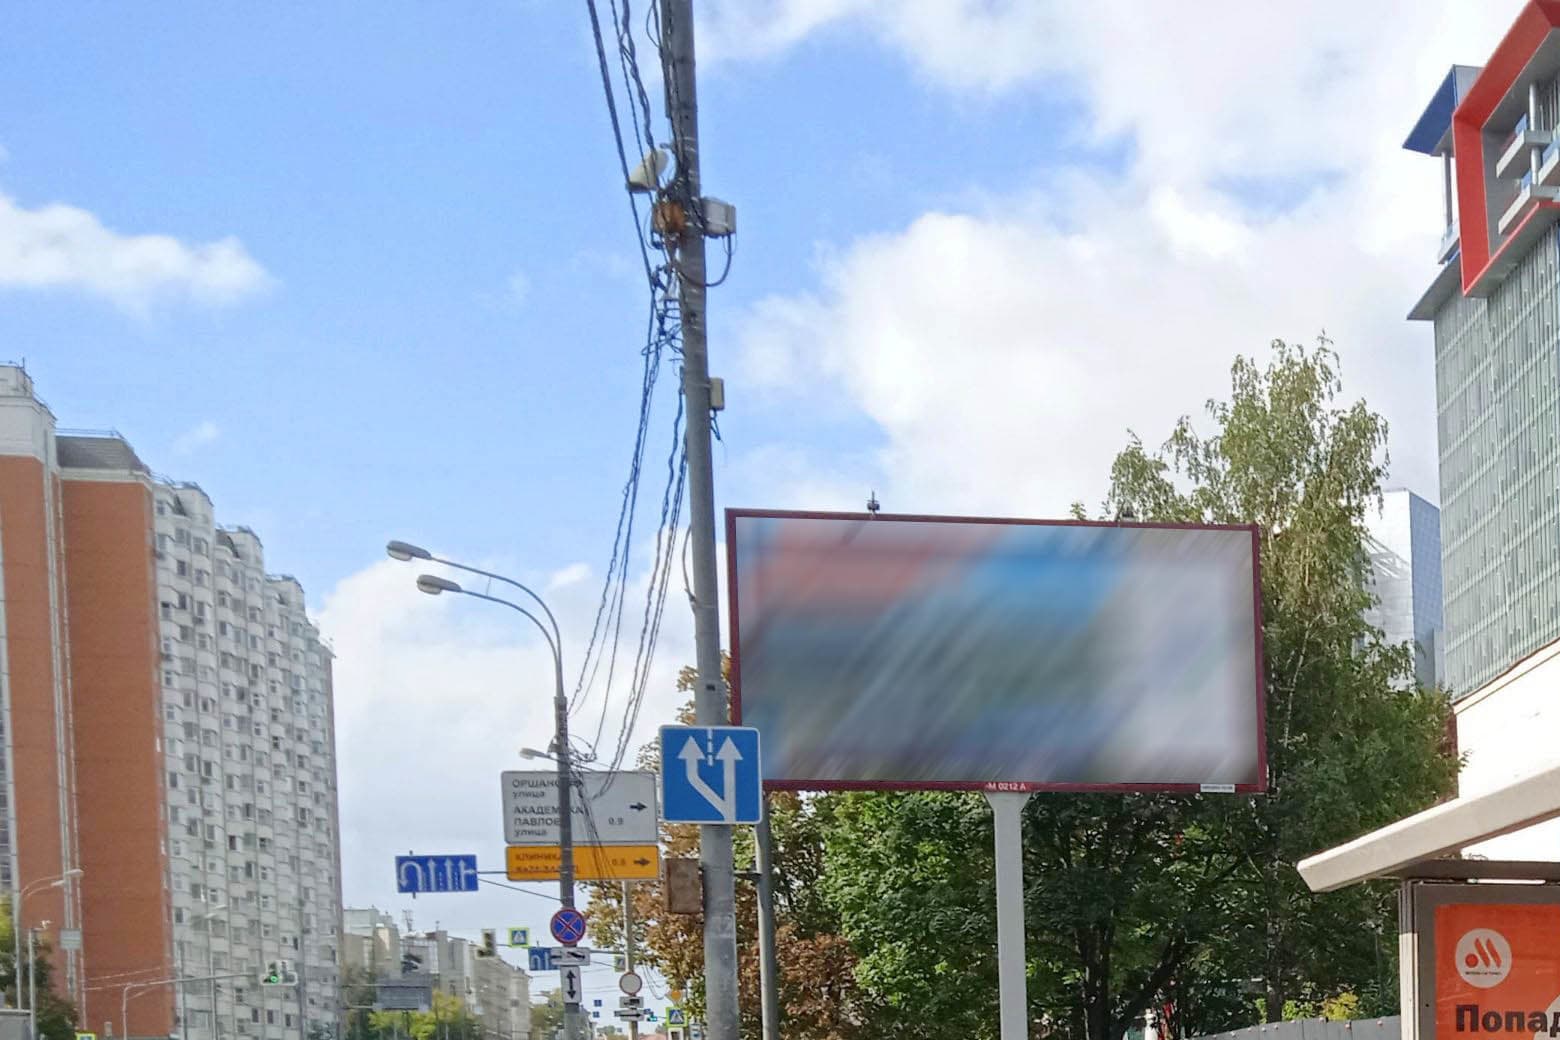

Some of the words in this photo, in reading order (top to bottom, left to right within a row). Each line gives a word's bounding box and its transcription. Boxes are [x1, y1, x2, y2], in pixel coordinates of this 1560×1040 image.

[512, 791, 545, 799] улица
[513, 806, 584, 815] АКАДЕМКА
[514, 818, 561, 826] ПАВЛОВ
[514, 828, 547, 837] улица
